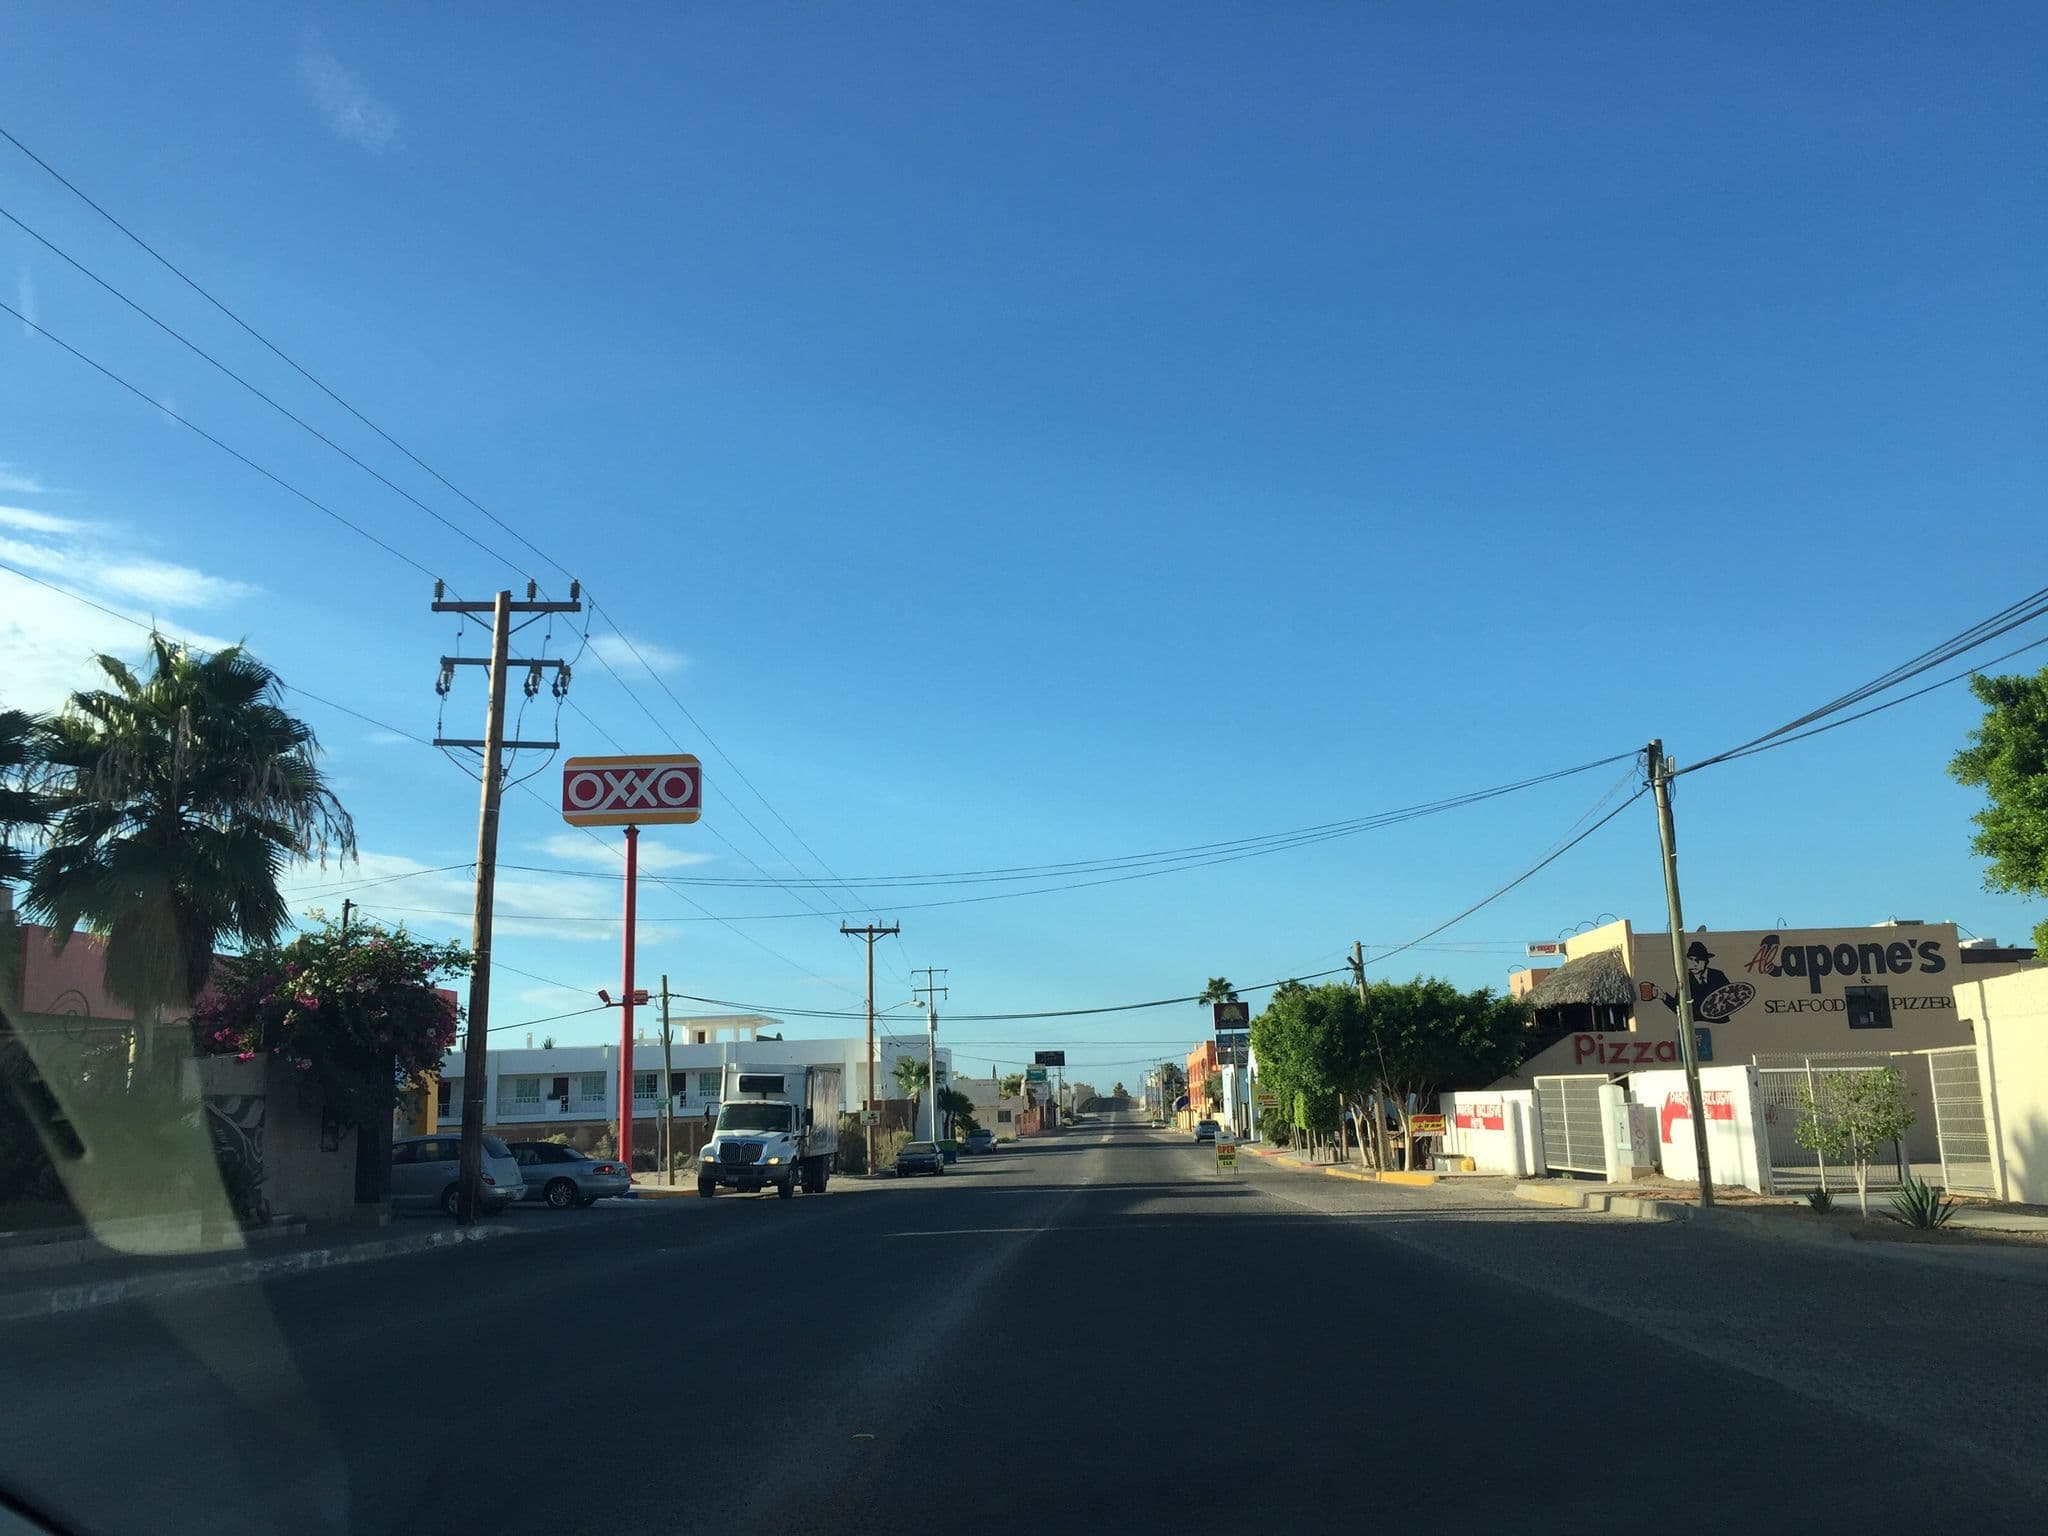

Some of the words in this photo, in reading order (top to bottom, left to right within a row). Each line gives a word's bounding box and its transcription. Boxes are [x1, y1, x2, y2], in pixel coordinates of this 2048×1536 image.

[568, 768, 694, 810] OXXO
[1744, 944, 1779, 974] Al
[1761, 935, 1946, 994] Capone's
[1860, 976, 1871, 984] &
[1764, 998, 1846, 1014] SEAFOOD
[1574, 1034, 1676, 1064] Pizza
